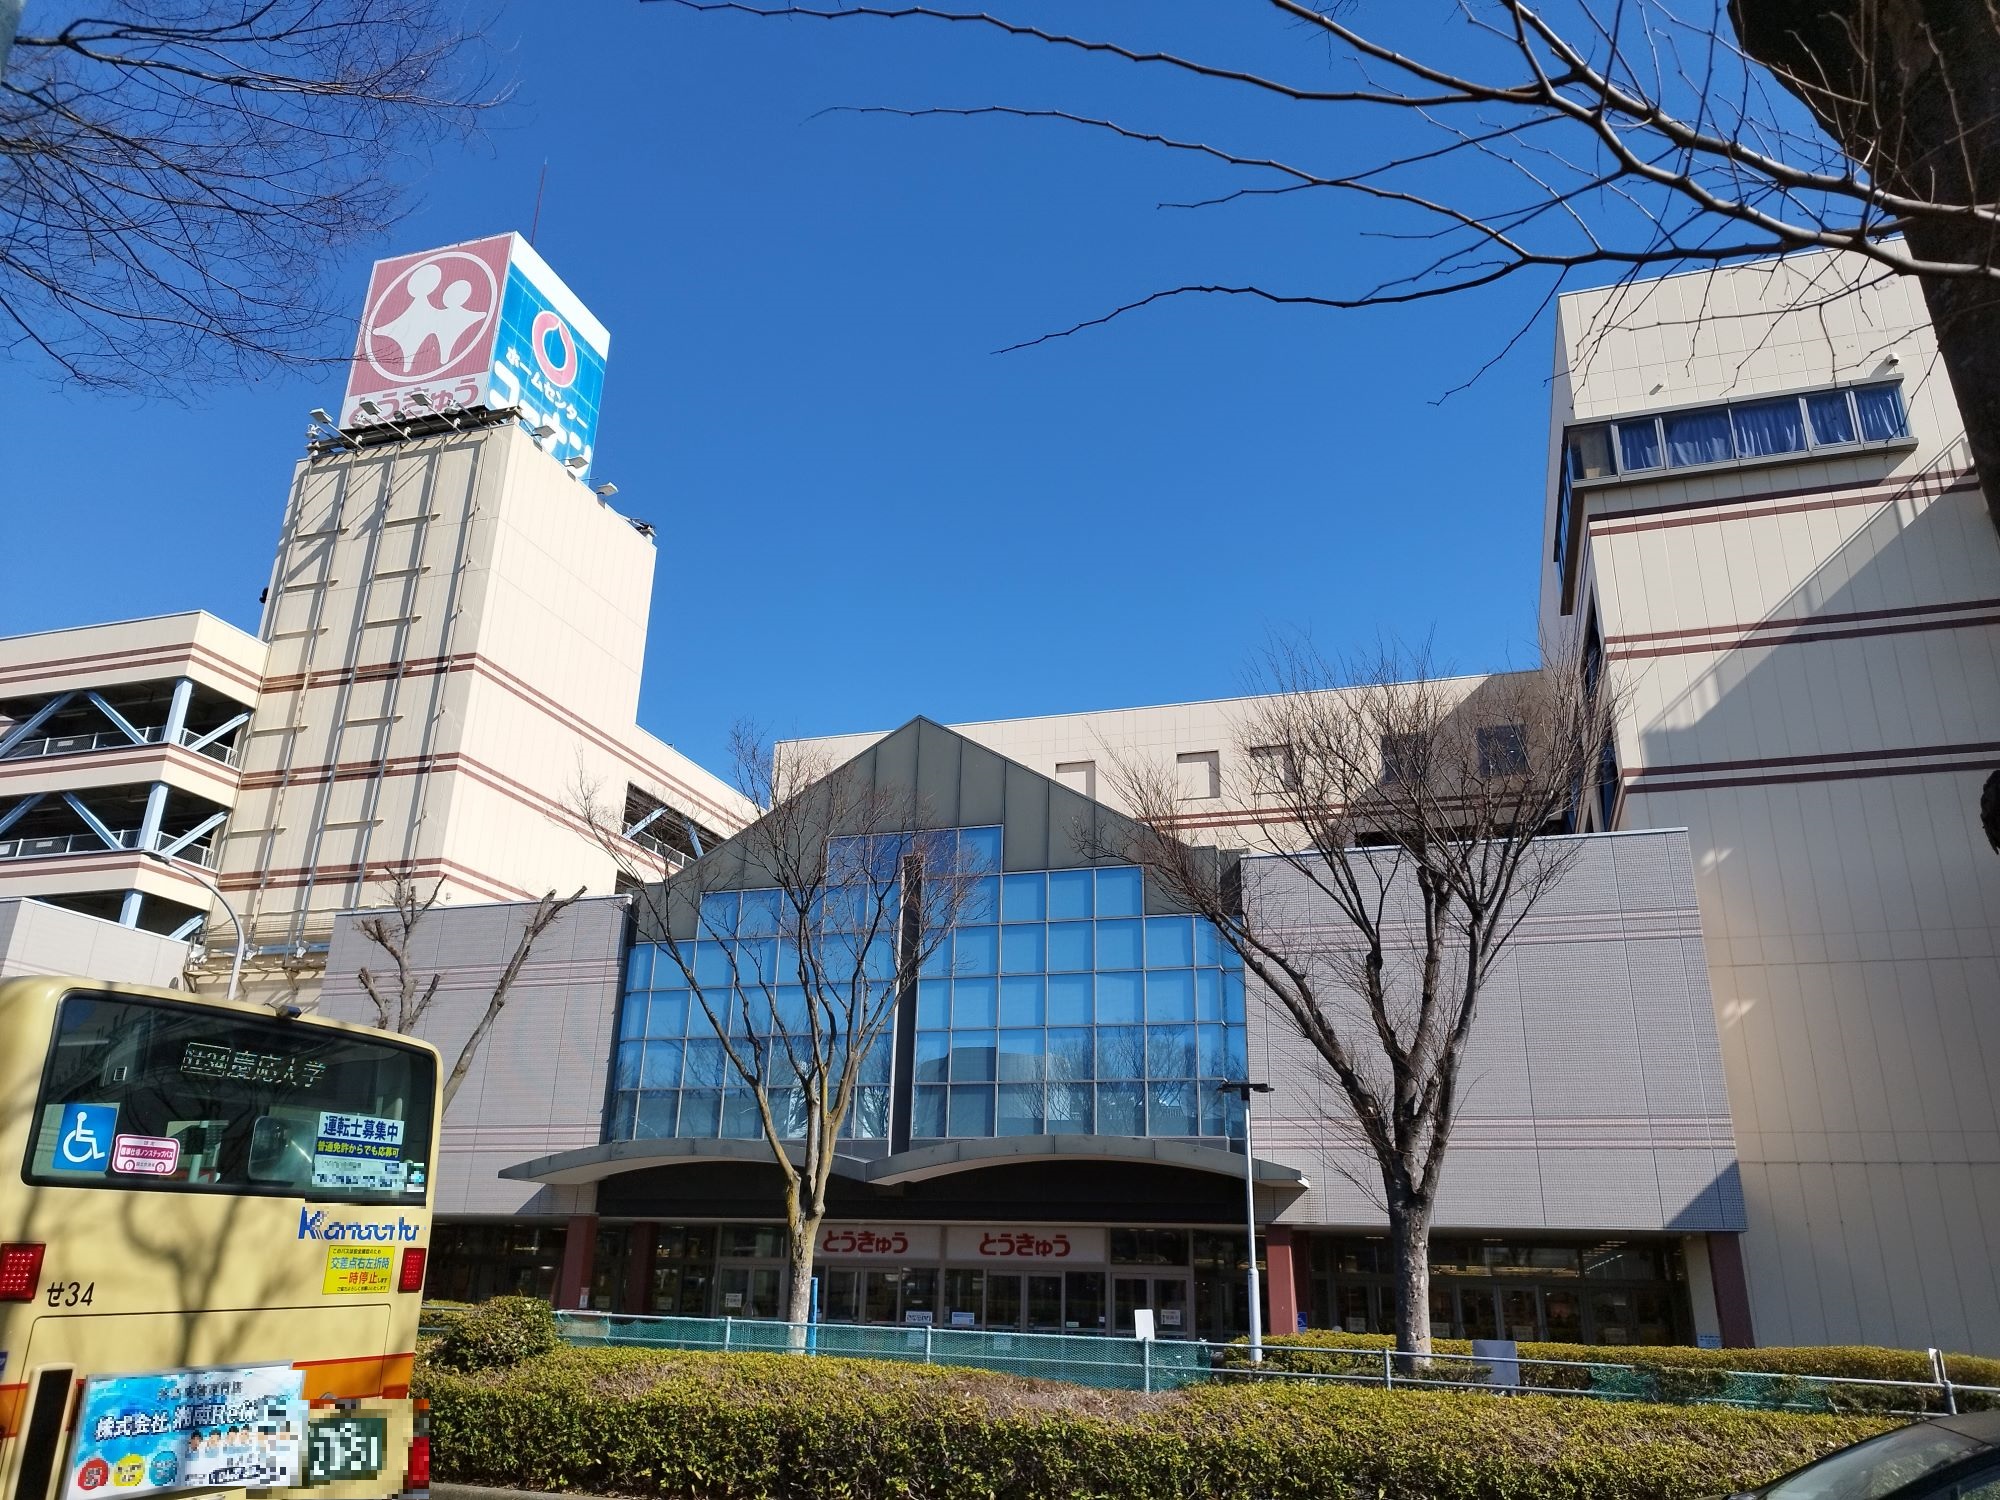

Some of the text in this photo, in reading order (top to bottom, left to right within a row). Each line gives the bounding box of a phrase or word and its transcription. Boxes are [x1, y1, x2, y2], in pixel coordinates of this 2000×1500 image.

[505, 345, 588, 428] ホームセンター
[349, 377, 479, 426] とうきゅう
[323, 1115, 399, 1142] 運転士募集中
[317, 1140, 400, 1159] 普通免許からでも応募可
[822, 1230, 909, 1254] とうきゅう
[979, 1232, 1071, 1257] とうきゅう
[331, 1257, 390, 1270] 交差点右左折時
[47, 1281, 95, 1307] せ34
